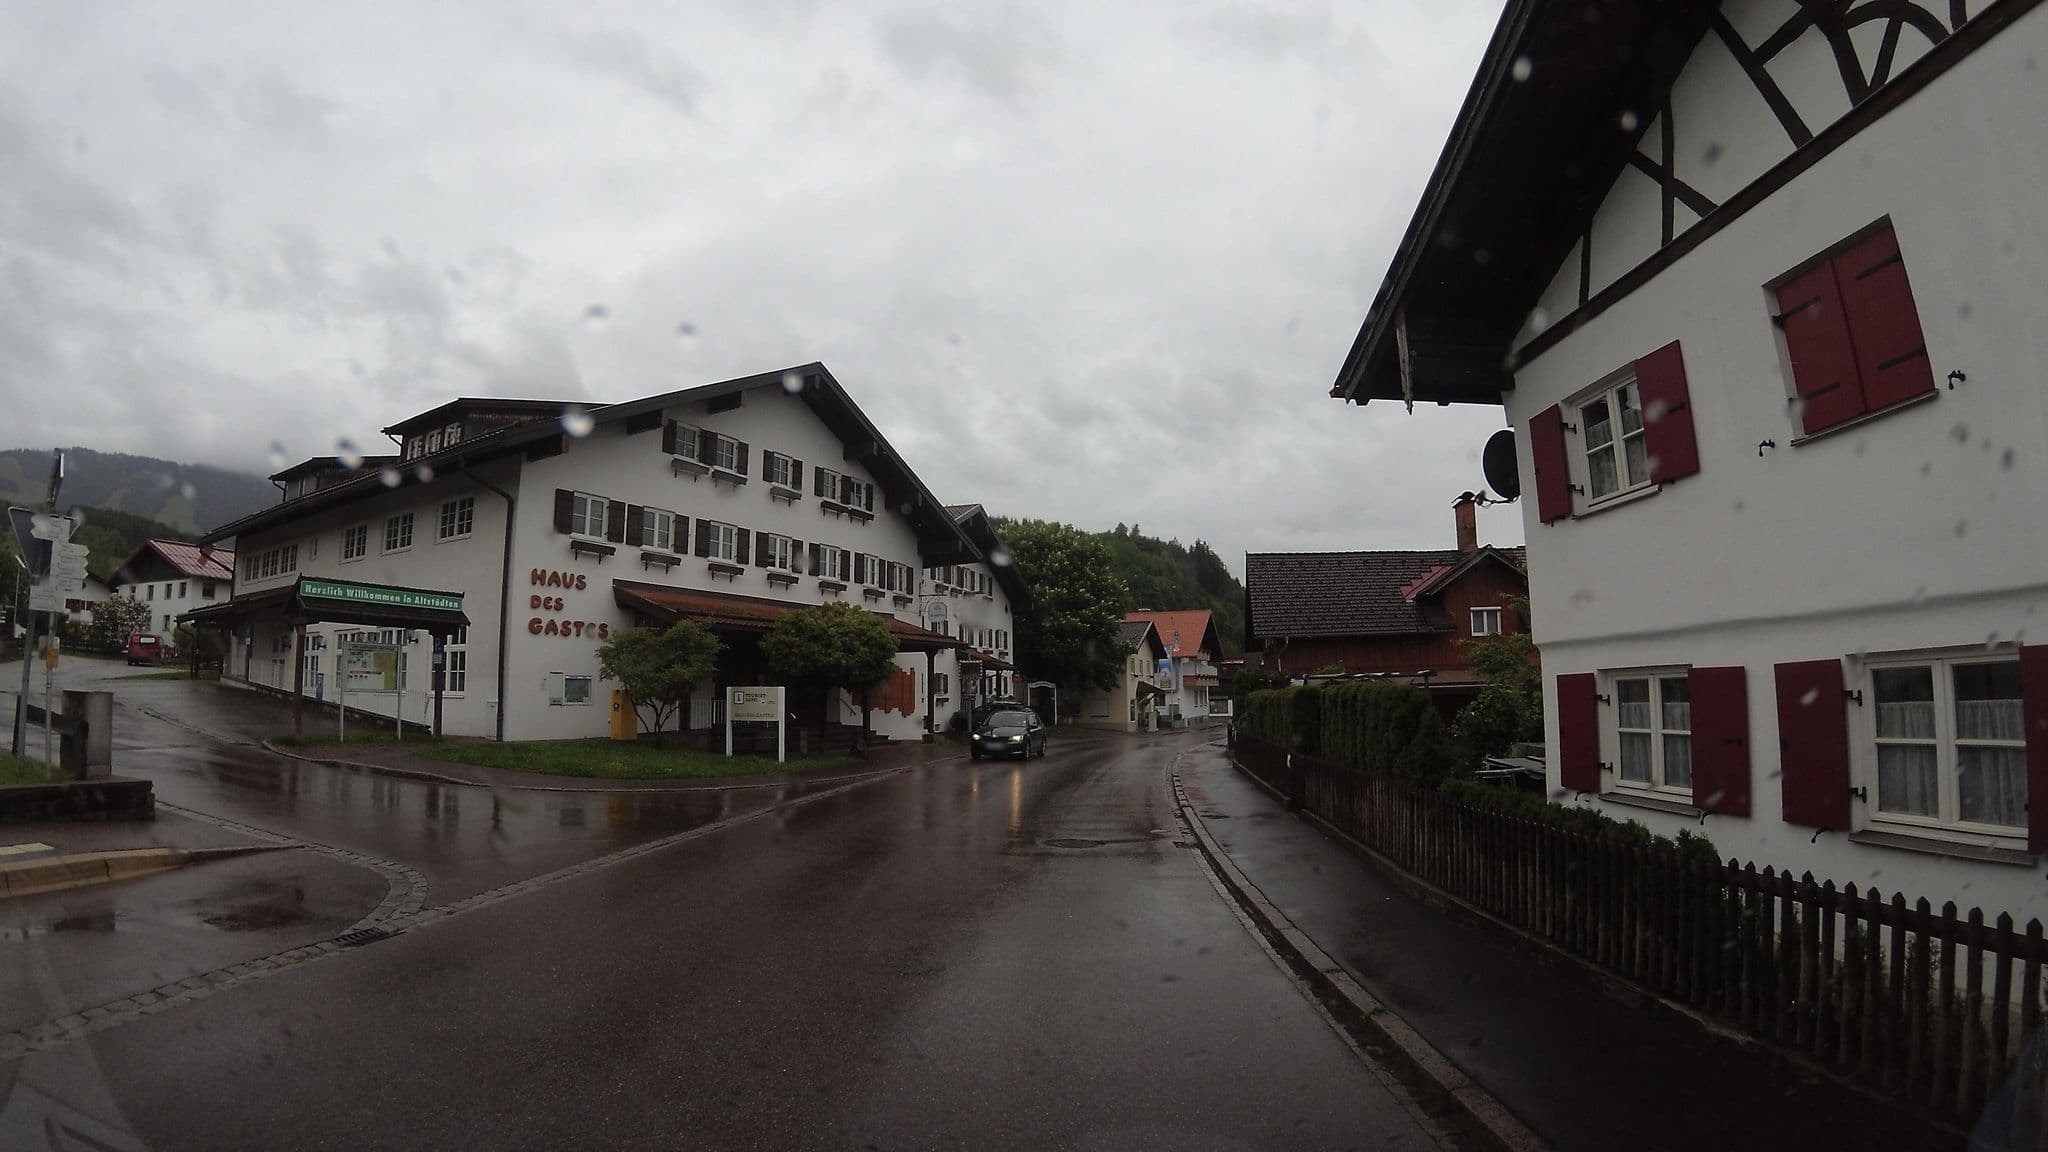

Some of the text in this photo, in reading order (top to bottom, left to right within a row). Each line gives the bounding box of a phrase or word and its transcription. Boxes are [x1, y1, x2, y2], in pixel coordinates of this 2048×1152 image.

[531, 568, 587, 591] HAUS
[305, 584, 459, 609] Herzlich Willkommen in Altstädten
[530, 594, 565, 611] DES
